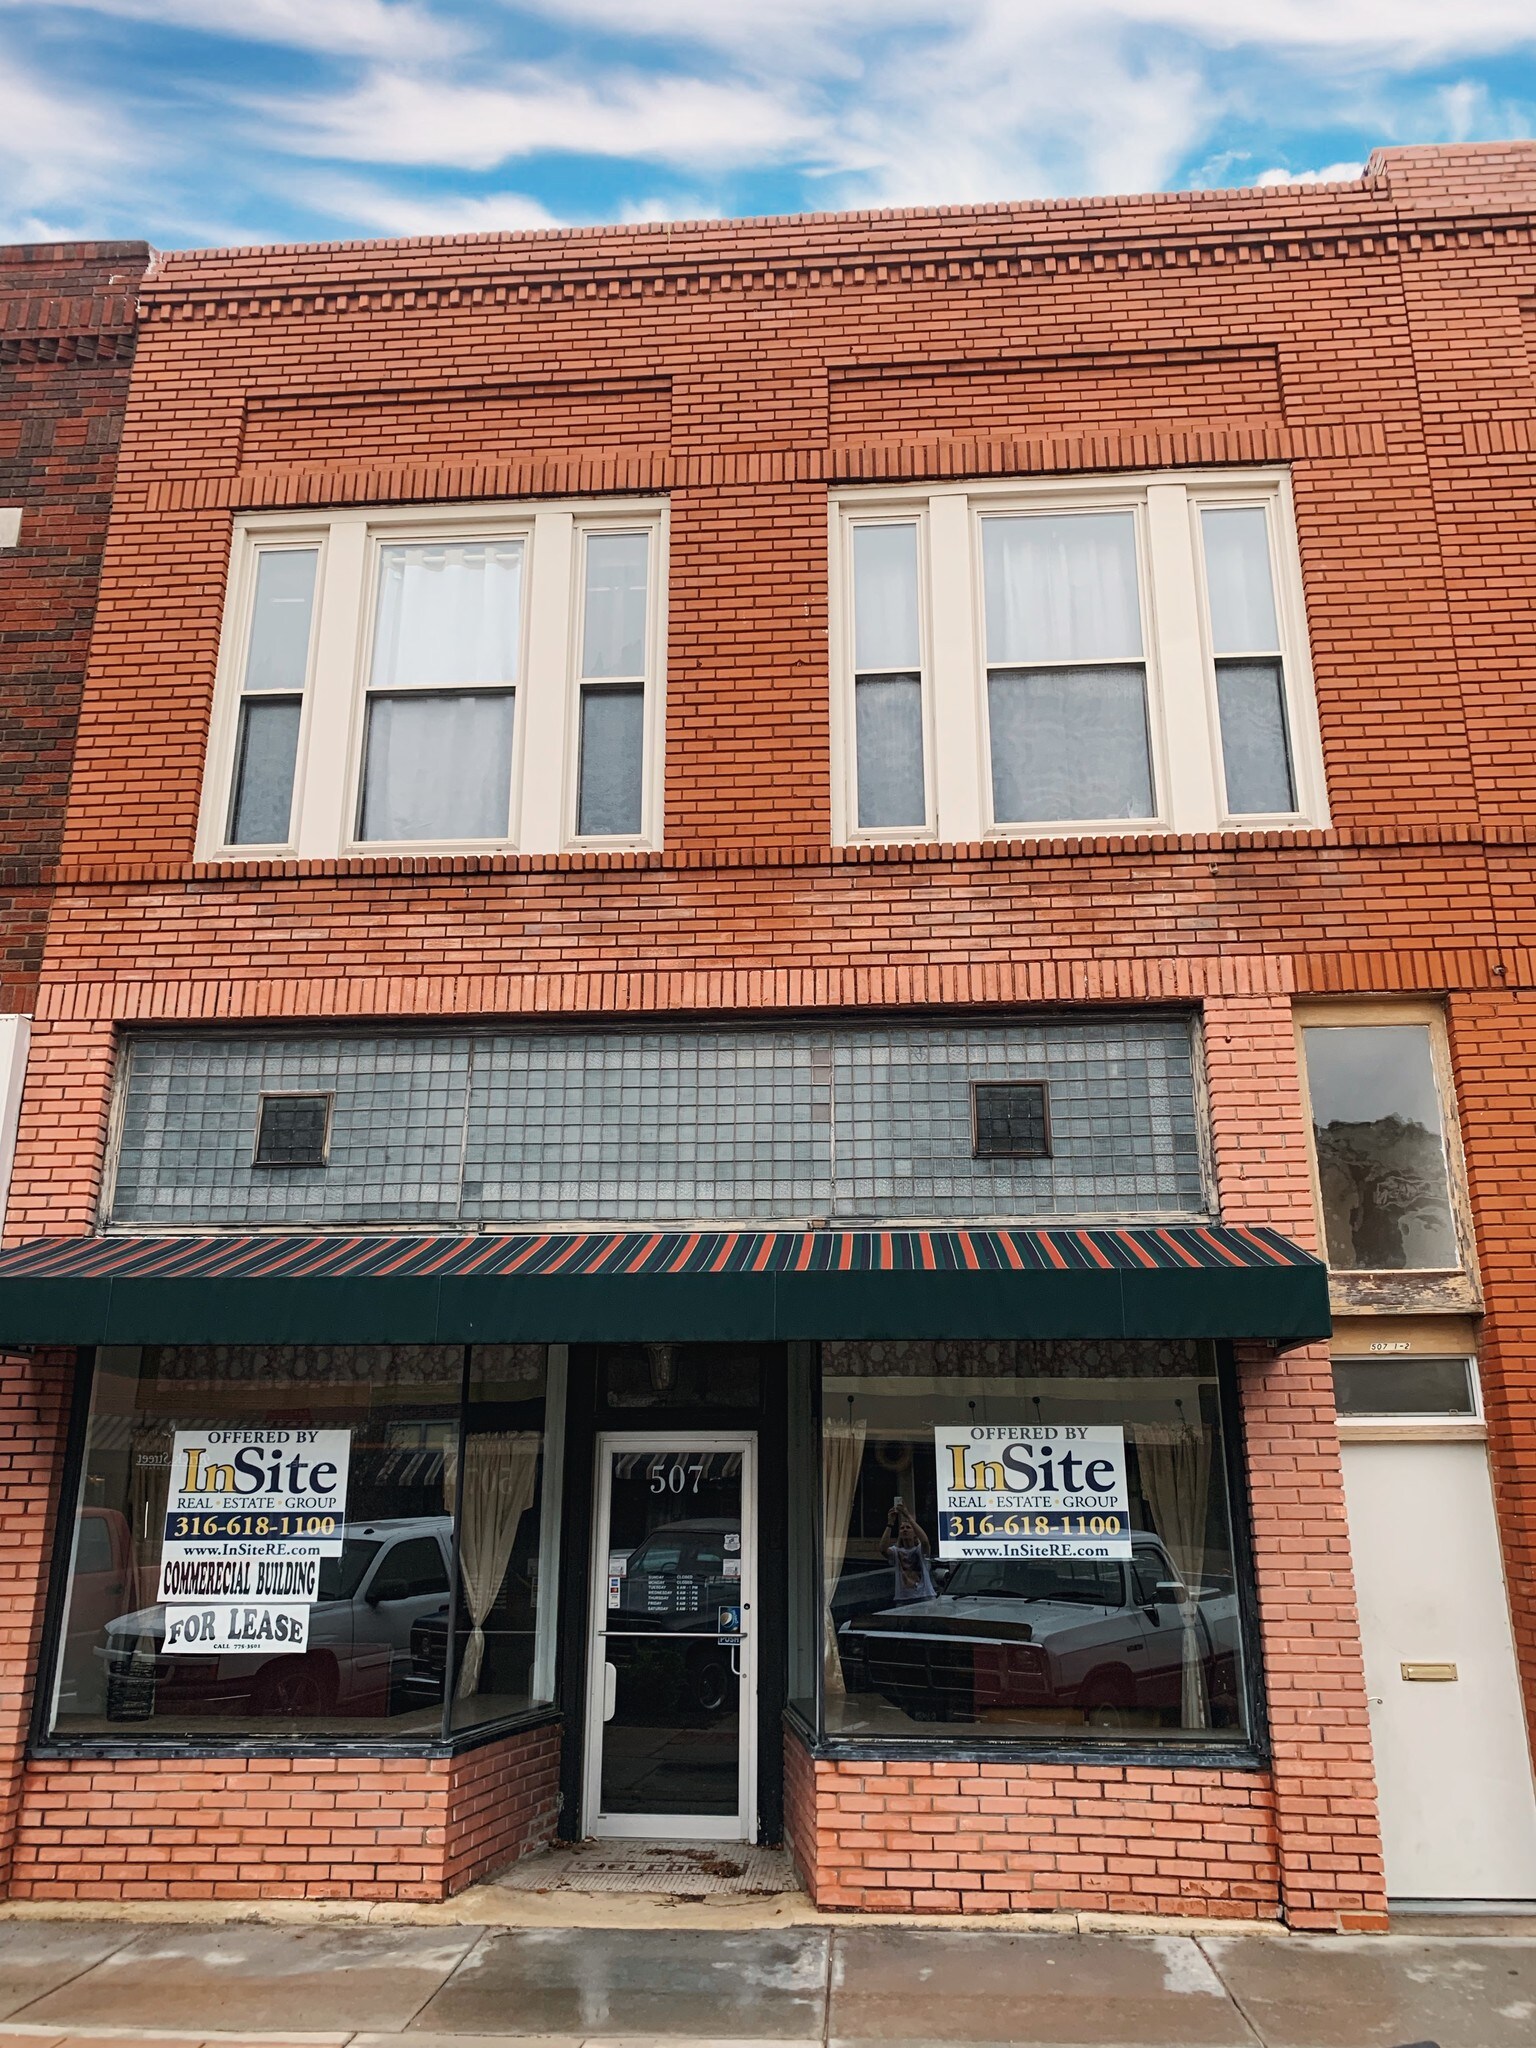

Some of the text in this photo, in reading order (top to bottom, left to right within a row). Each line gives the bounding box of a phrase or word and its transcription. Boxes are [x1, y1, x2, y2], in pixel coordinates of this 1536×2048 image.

[207, 1430, 319, 1444] OFFERED BY
[970, 1427, 1089, 1440] OFFERED BY
[178, 1446, 338, 1494] InSite
[945, 1443, 1116, 1493] InSite
[650, 1465, 704, 1494] 507
[176, 1497, 337, 1509] REAL ESTATE GROUP
[948, 1495, 1118, 1508] REAL ESTATE GROUP
[174, 1515, 335, 1537] 316-618-1100
[949, 1515, 1121, 1537] 316-618-1100
[184, 1543, 321, 1556] www.InSiteRE.com
[961, 1543, 1109, 1557] www.InSiteRE.com
[163, 1561, 315, 1596] COMMERECIAL BUILDING
[168, 1608, 303, 1645] FOR LEASE
